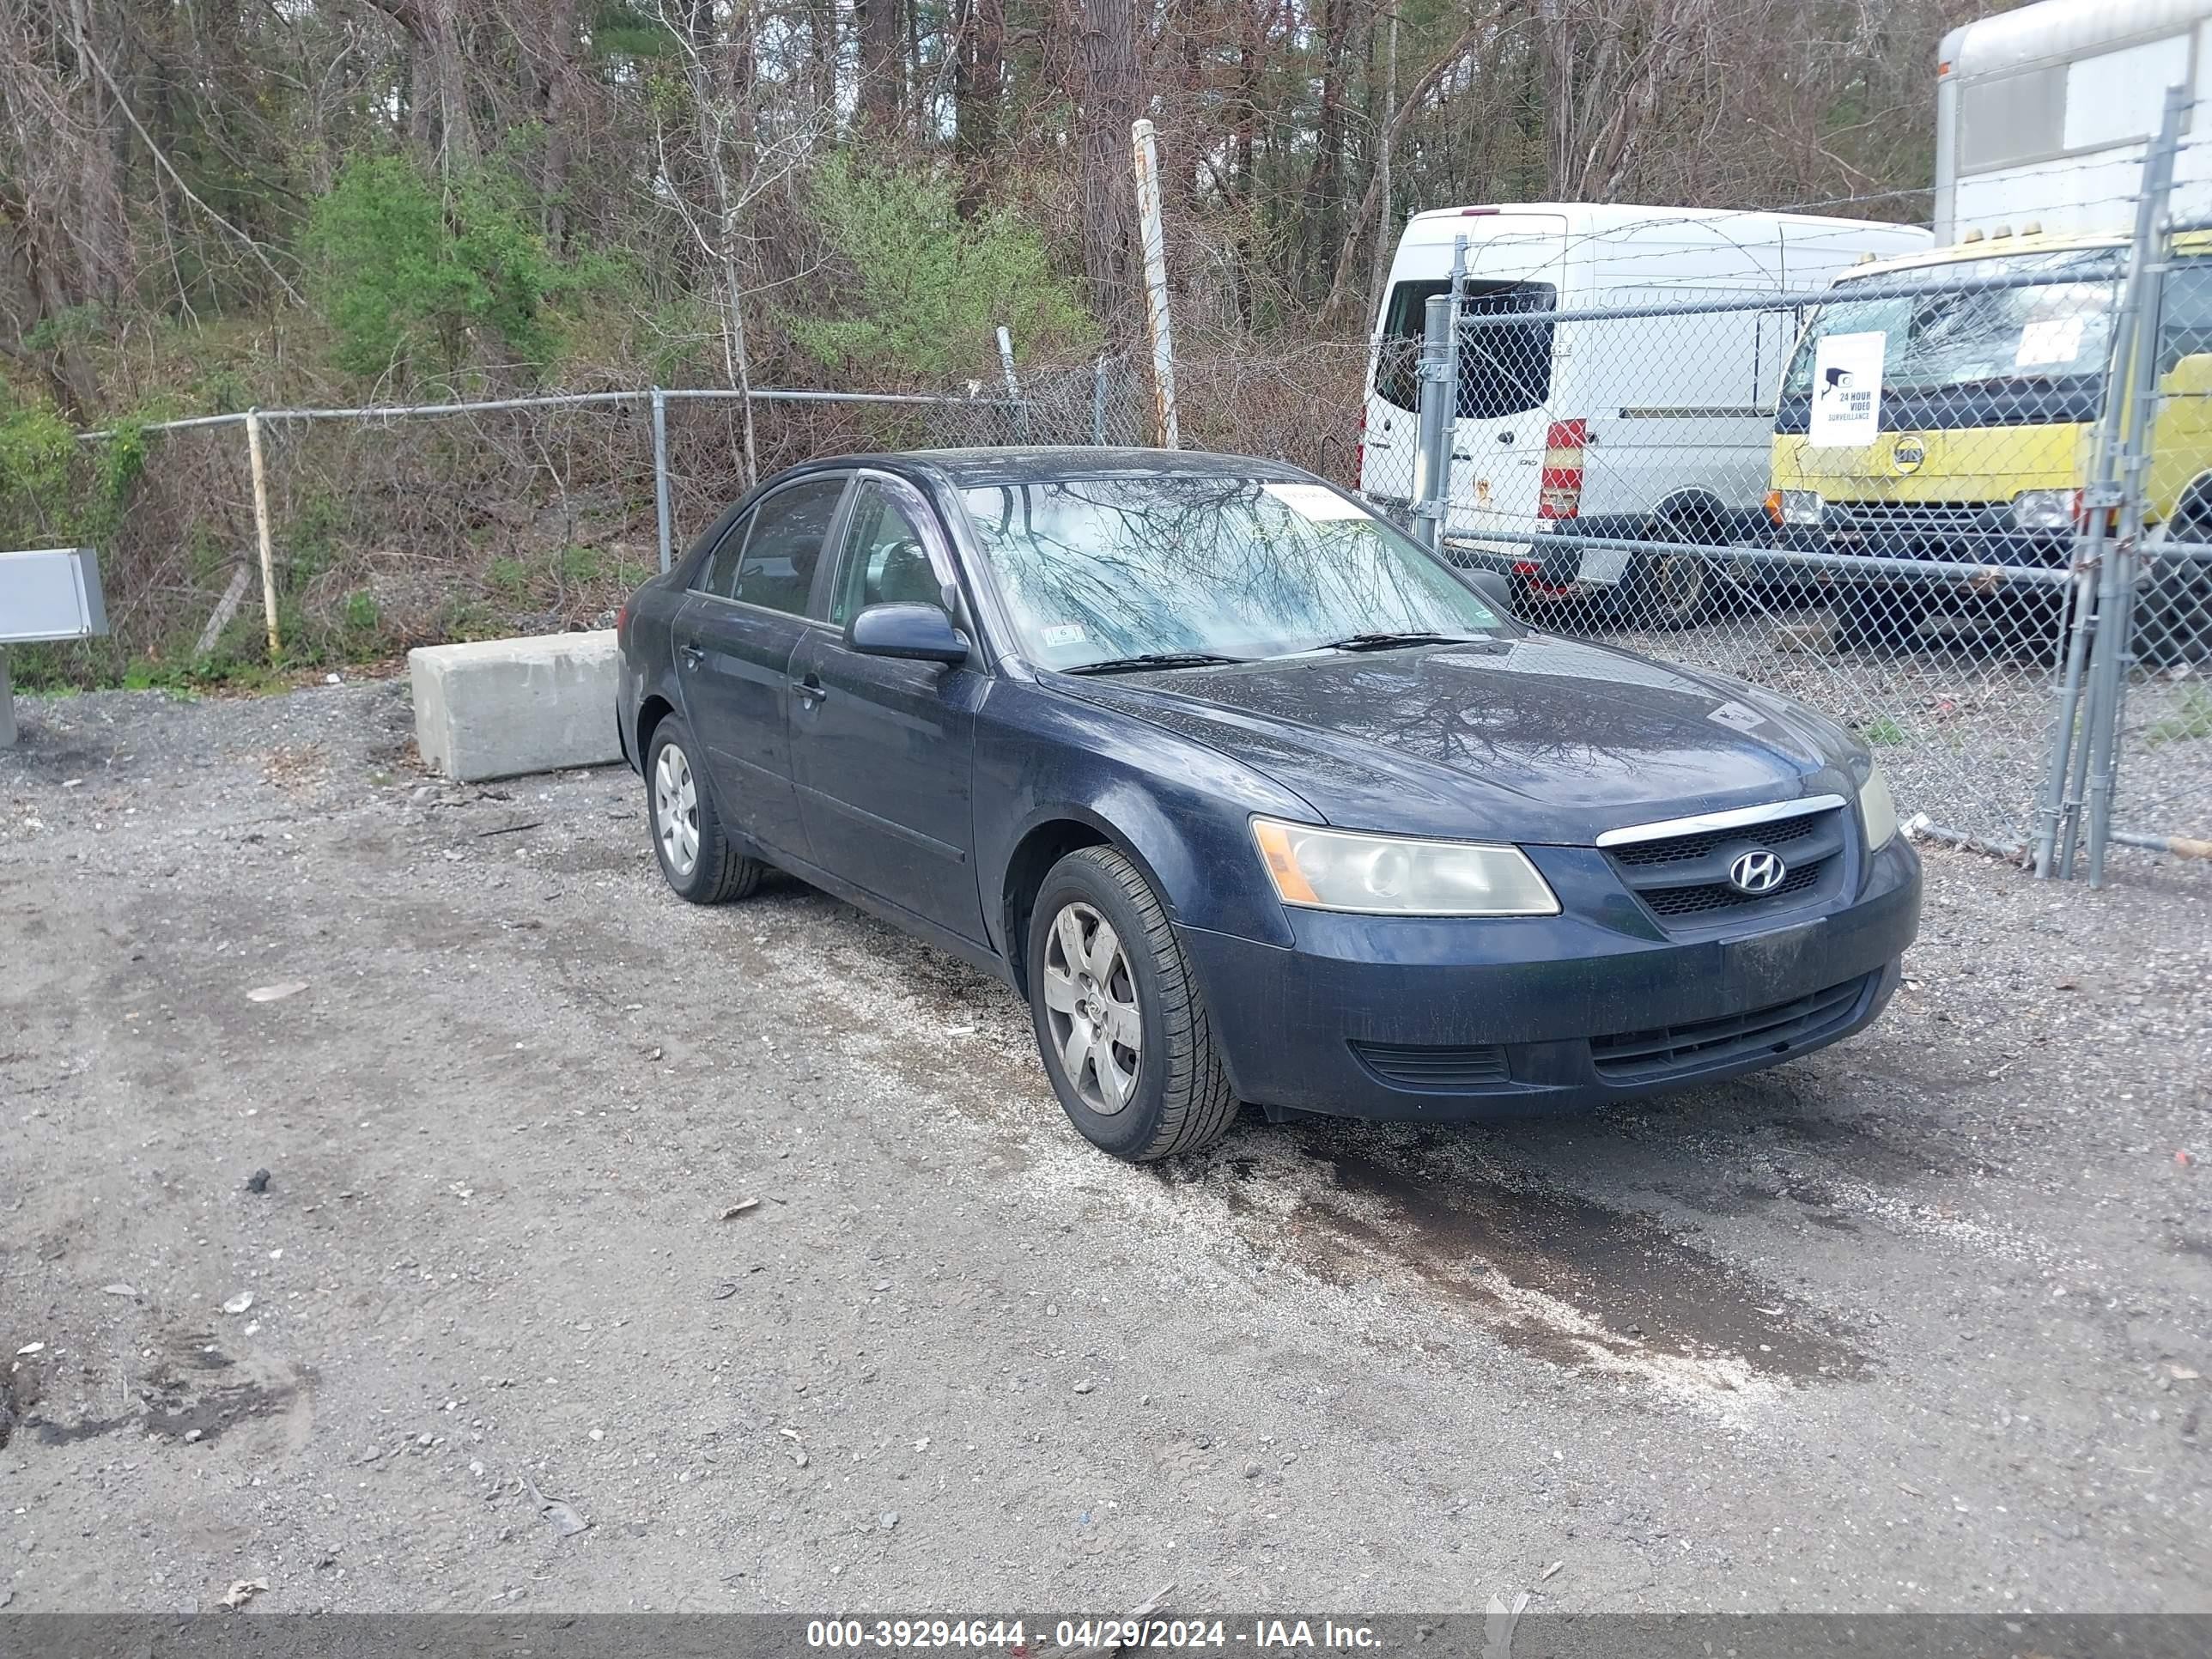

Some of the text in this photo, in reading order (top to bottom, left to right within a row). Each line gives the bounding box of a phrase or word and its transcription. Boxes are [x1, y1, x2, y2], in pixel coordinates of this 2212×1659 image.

[1839, 392, 1871, 402] 24 HOUR
[1850, 402, 1870, 410] VIDEO
[1828, 413, 1869, 422] SURVEILLANCE
